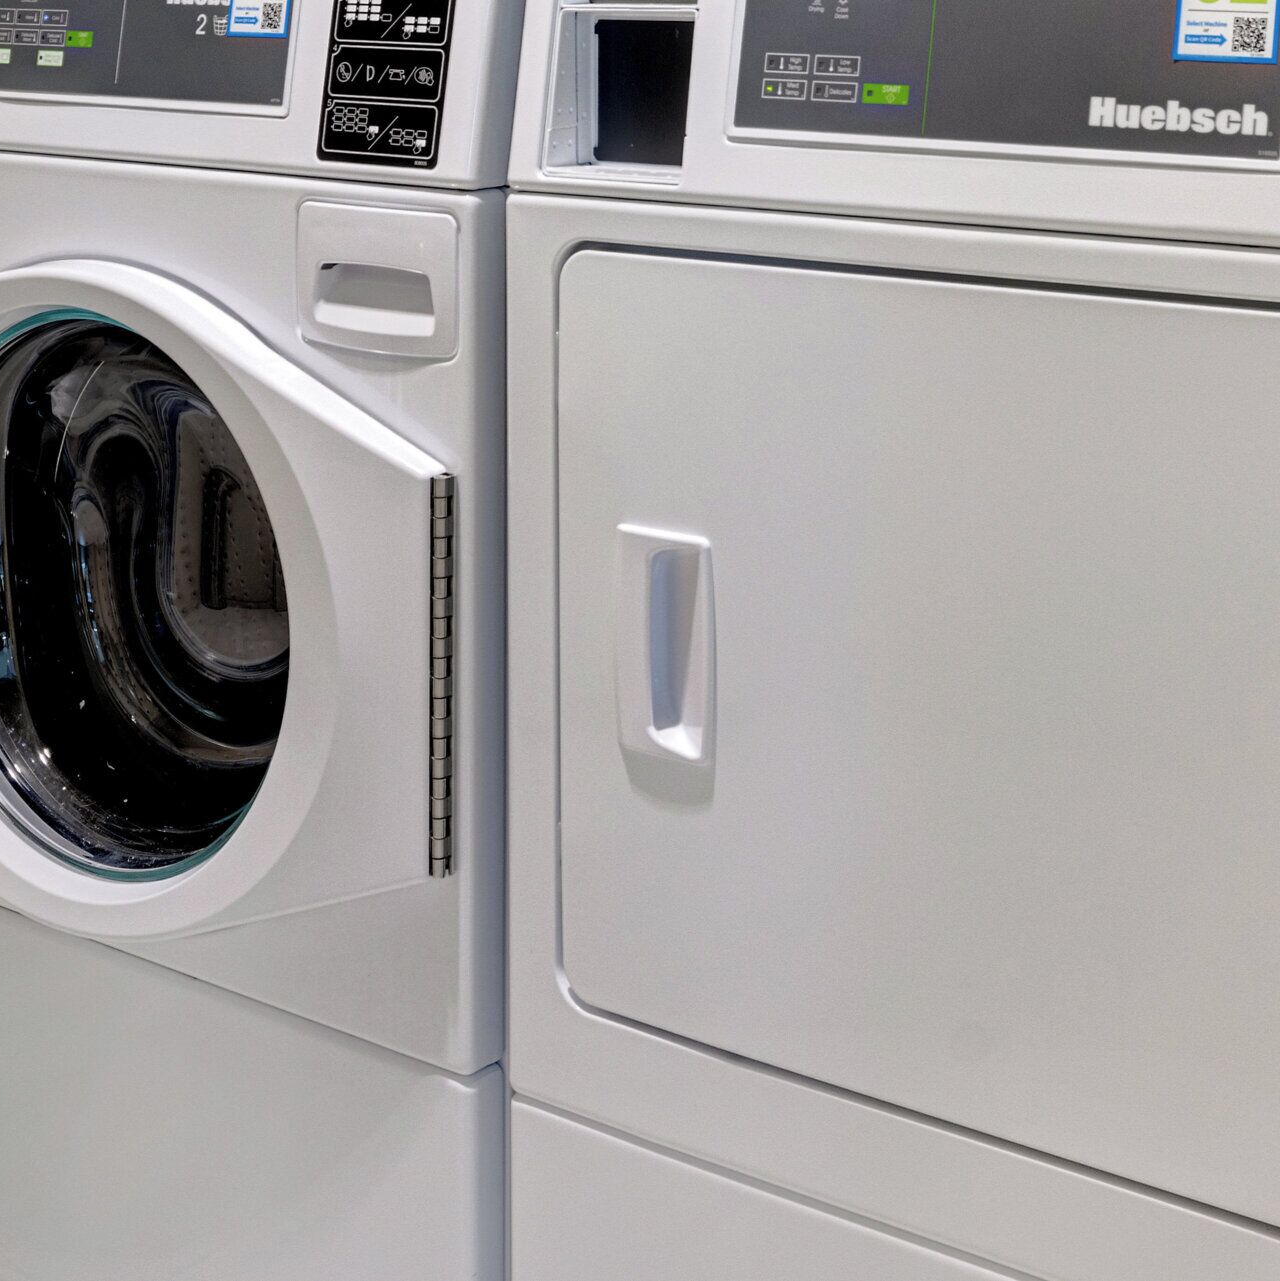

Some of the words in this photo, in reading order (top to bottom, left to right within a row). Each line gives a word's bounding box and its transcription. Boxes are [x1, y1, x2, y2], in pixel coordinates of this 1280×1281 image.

[195, 14, 207, 35] 2
[1186, 20, 1204, 28] Select
[1205, 21, 1228, 29] Machine
[1199, 36, 1208, 44] QR
[882, 84, 901, 94] START
[1088, 96, 1269, 137] Huebsch
